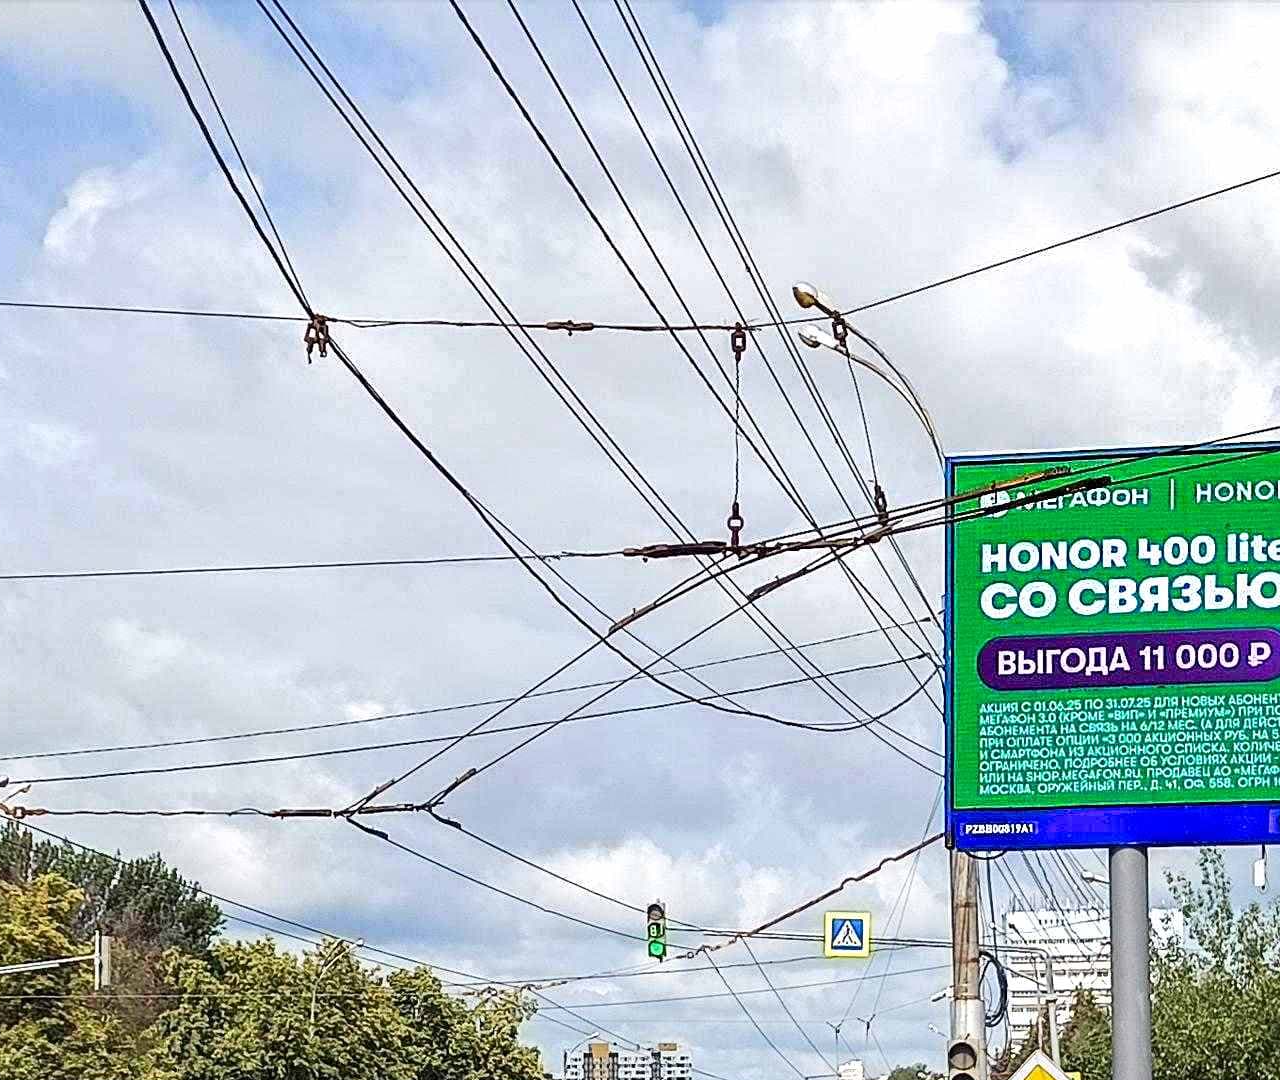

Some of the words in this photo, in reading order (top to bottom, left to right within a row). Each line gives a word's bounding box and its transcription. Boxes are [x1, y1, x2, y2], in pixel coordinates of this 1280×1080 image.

[981, 538, 1127, 573] HONOR
[1138, 535, 1216, 566] 400
[981, 581, 1056, 620] СО
[997, 646, 1131, 677] ВЫГОДА
[1139, 644, 1164, 671] 11
[1175, 643, 1239, 670] 000
[980, 702, 1018, 713] АКЦИЯ
[1021, 701, 1031, 712] С
[1085, 699, 1103, 710] ПО
[1154, 697, 1178, 707] ДЛЯ
[1182, 695, 1225, 706] НОВЫХ
[980, 713, 1035, 725] МЕГАФОН
[1038, 712, 1056, 723] 3.0
[1058, 711, 1104, 722] (КРОМЕ
[1148, 709, 1156, 719] И
[1238, 706, 1262, 716] ПРИ
[980, 724, 1057, 737] АБОНЕМЕНТА
[1061, 723, 1076, 734] НА
[1079, 722, 1118, 733] СВЯЗЬ
[1122, 721, 1137, 732] НА
[1215, 718, 1240, 729] ДЛЯ
[980, 738, 1003, 749] ПРИ
[1007, 736, 1052, 748] ОПЛАТЕ
[1056, 735, 1099, 746] ОПЦИИ
[1118, 733, 1141, 744] 000
[1145, 731, 1221, 743] АКЦИОННЫХ
[1253, 729, 1268, 740] НА
[1272, 729, 1279, 739] 5
[980, 750, 988, 760] И
[991, 748, 1065, 760] СМАРТФОНА
[1069, 747, 1084, 757] ИЗ
[1087, 744, 1172, 757] АКЦИОННОГО
[1064, 757, 1136, 769] ПОДРОБНЕЕ
[1140, 756, 1158, 767] ОБ
[1160, 754, 1227, 766] УСЛОВИЯХ
[1230, 752, 1271, 764] АКЦИИ
[980, 773, 1004, 784] ИЛИ
[1008, 773, 1023, 783] НА
[1147, 766, 1210, 778] ПРОДАВЕЦ
[1214, 766, 1231, 776] АО
[1038, 781, 1114, 794] ОРУЖЕЙНЫЙ
[1238, 776, 1270, 787] ОГРН
